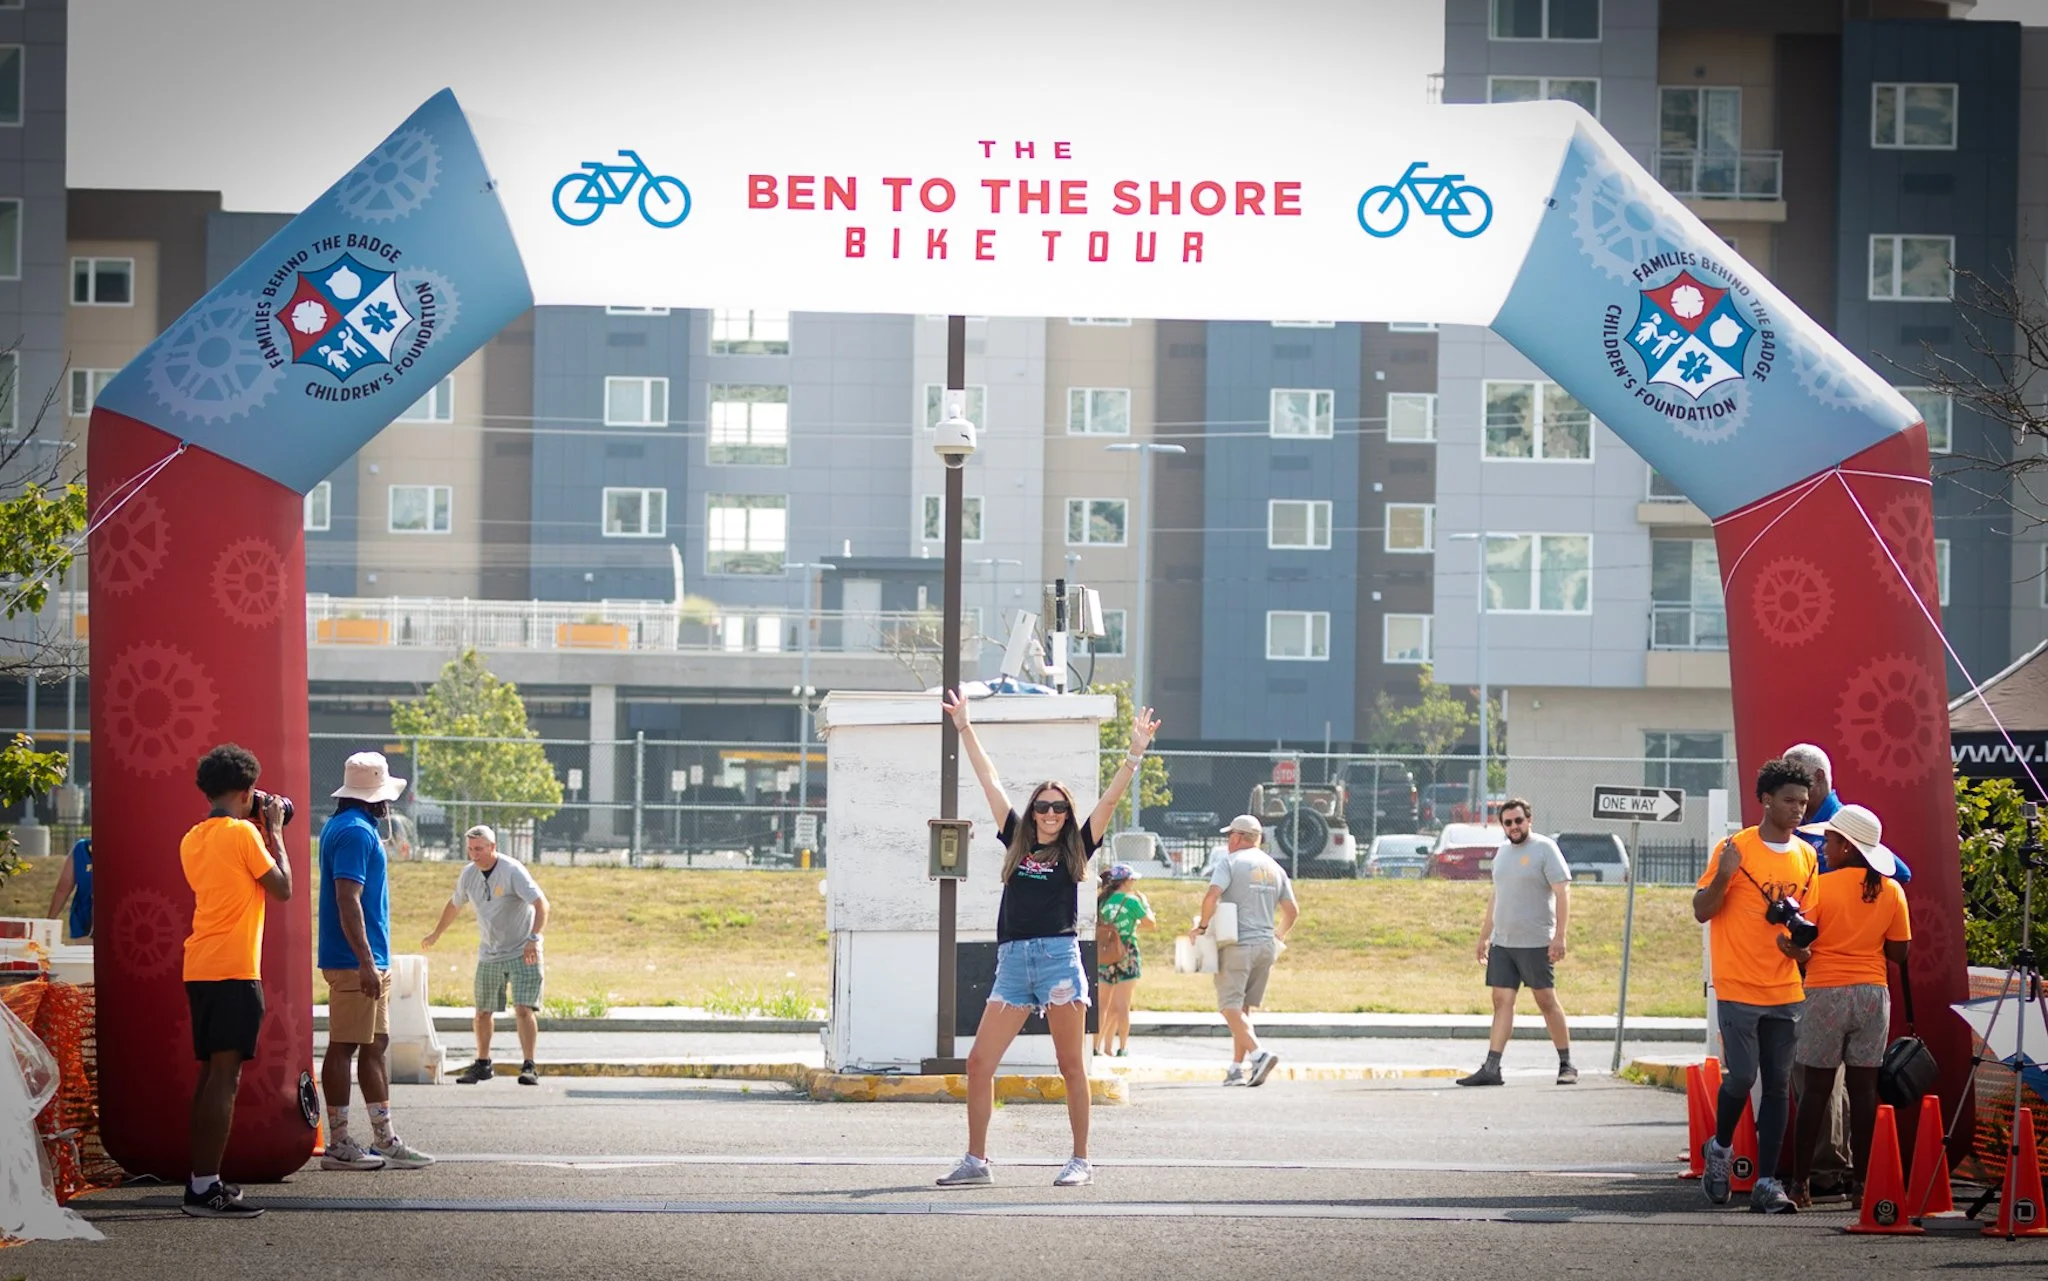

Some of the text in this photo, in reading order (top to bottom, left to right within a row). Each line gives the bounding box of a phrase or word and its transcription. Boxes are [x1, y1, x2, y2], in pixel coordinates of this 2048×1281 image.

[978, 140, 1072, 159] THE
[748, 174, 1302, 217] BEN TO THE SHORE
[845, 227, 1203, 263] BIKE TOUR
[255, 233, 403, 369] FAMILIES BEHIND THE BADGE
[1632, 251, 1776, 382] FAMILIES BEHIND THE BADGE
[305, 281, 436, 402] CHILDREN'S FOUNDATION
[1603, 304, 1737, 421] CHILDREN'S FOUNDATION
[1602, 796, 1657, 811] ONE WAY
